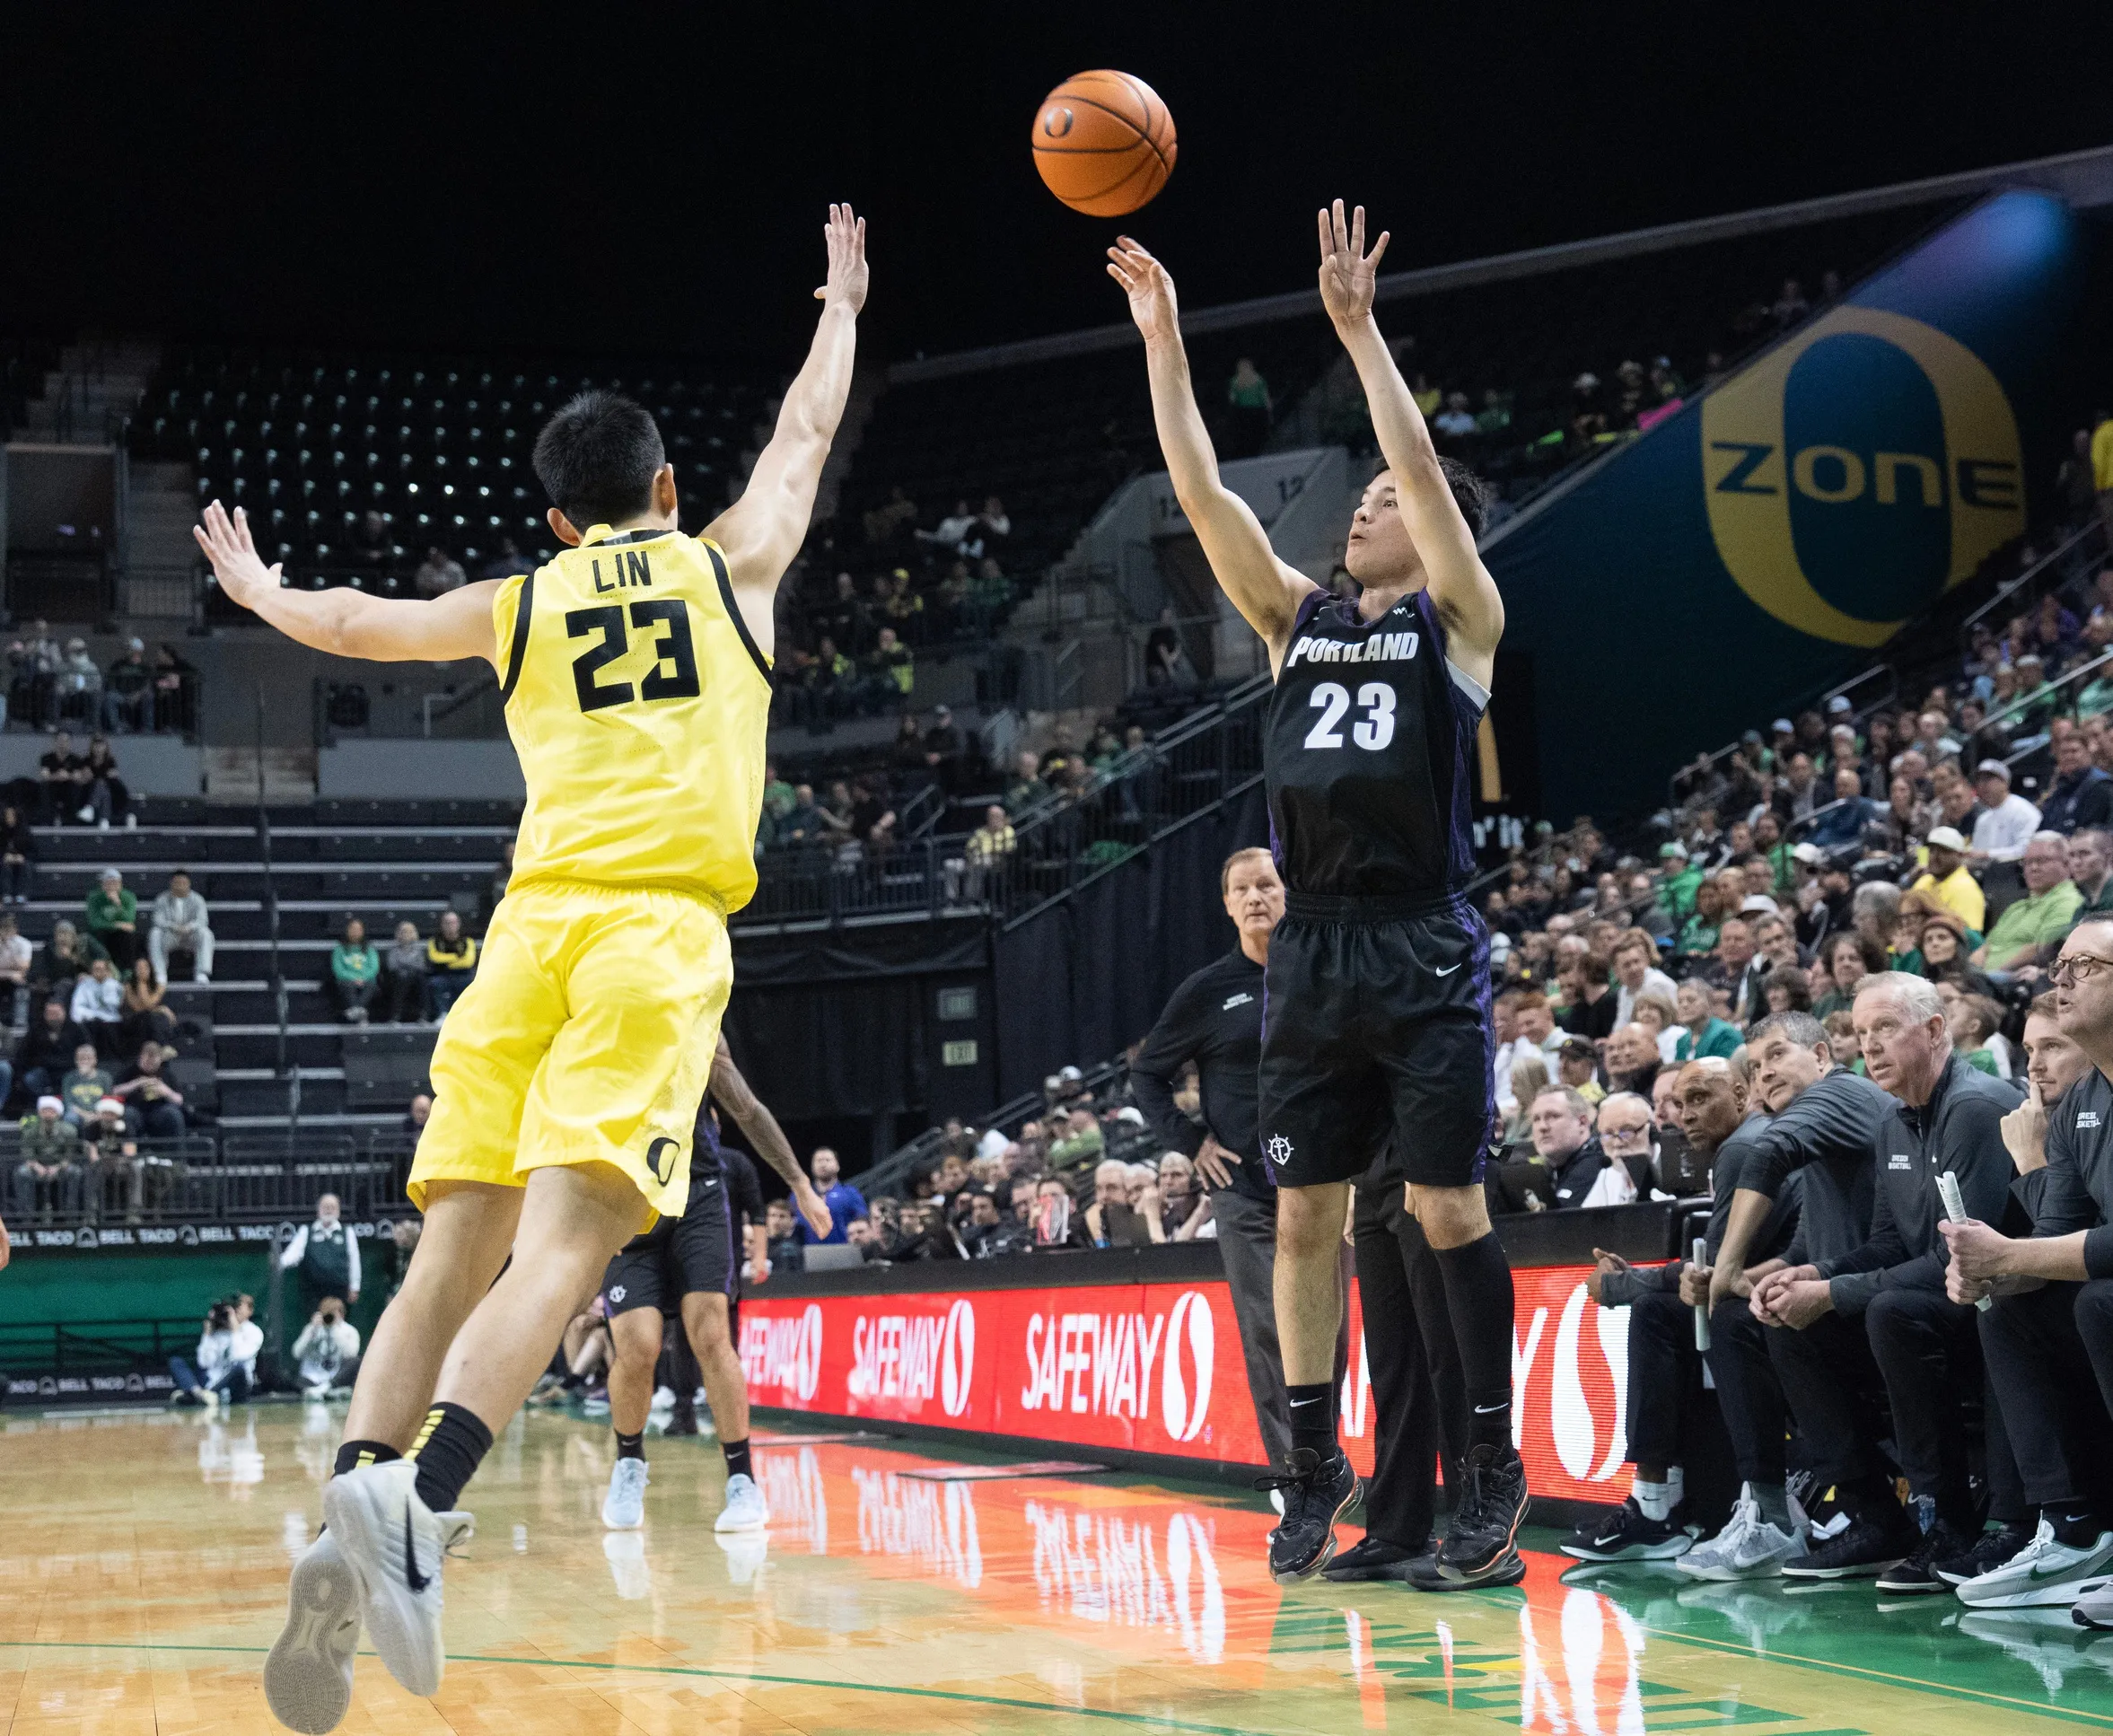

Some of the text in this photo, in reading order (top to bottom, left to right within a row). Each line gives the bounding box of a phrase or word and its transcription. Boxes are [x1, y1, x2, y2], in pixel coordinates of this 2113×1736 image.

[592, 551, 652, 592] LIN
[566, 600, 700, 713] 23
[1286, 632, 1419, 668] PORTLAND
[1303, 682, 1397, 750] 23
[35, 1230, 75, 1246] TACO
[99, 1229, 135, 1245] BELL
[137, 1227, 178, 1243] TACO
[198, 1226, 235, 1242] BELL
[739, 1317, 803, 1394] AFEWAY
[847, 1314, 947, 1400] SAFEWAY
[1021, 1312, 1165, 1420] SAFEWAY
